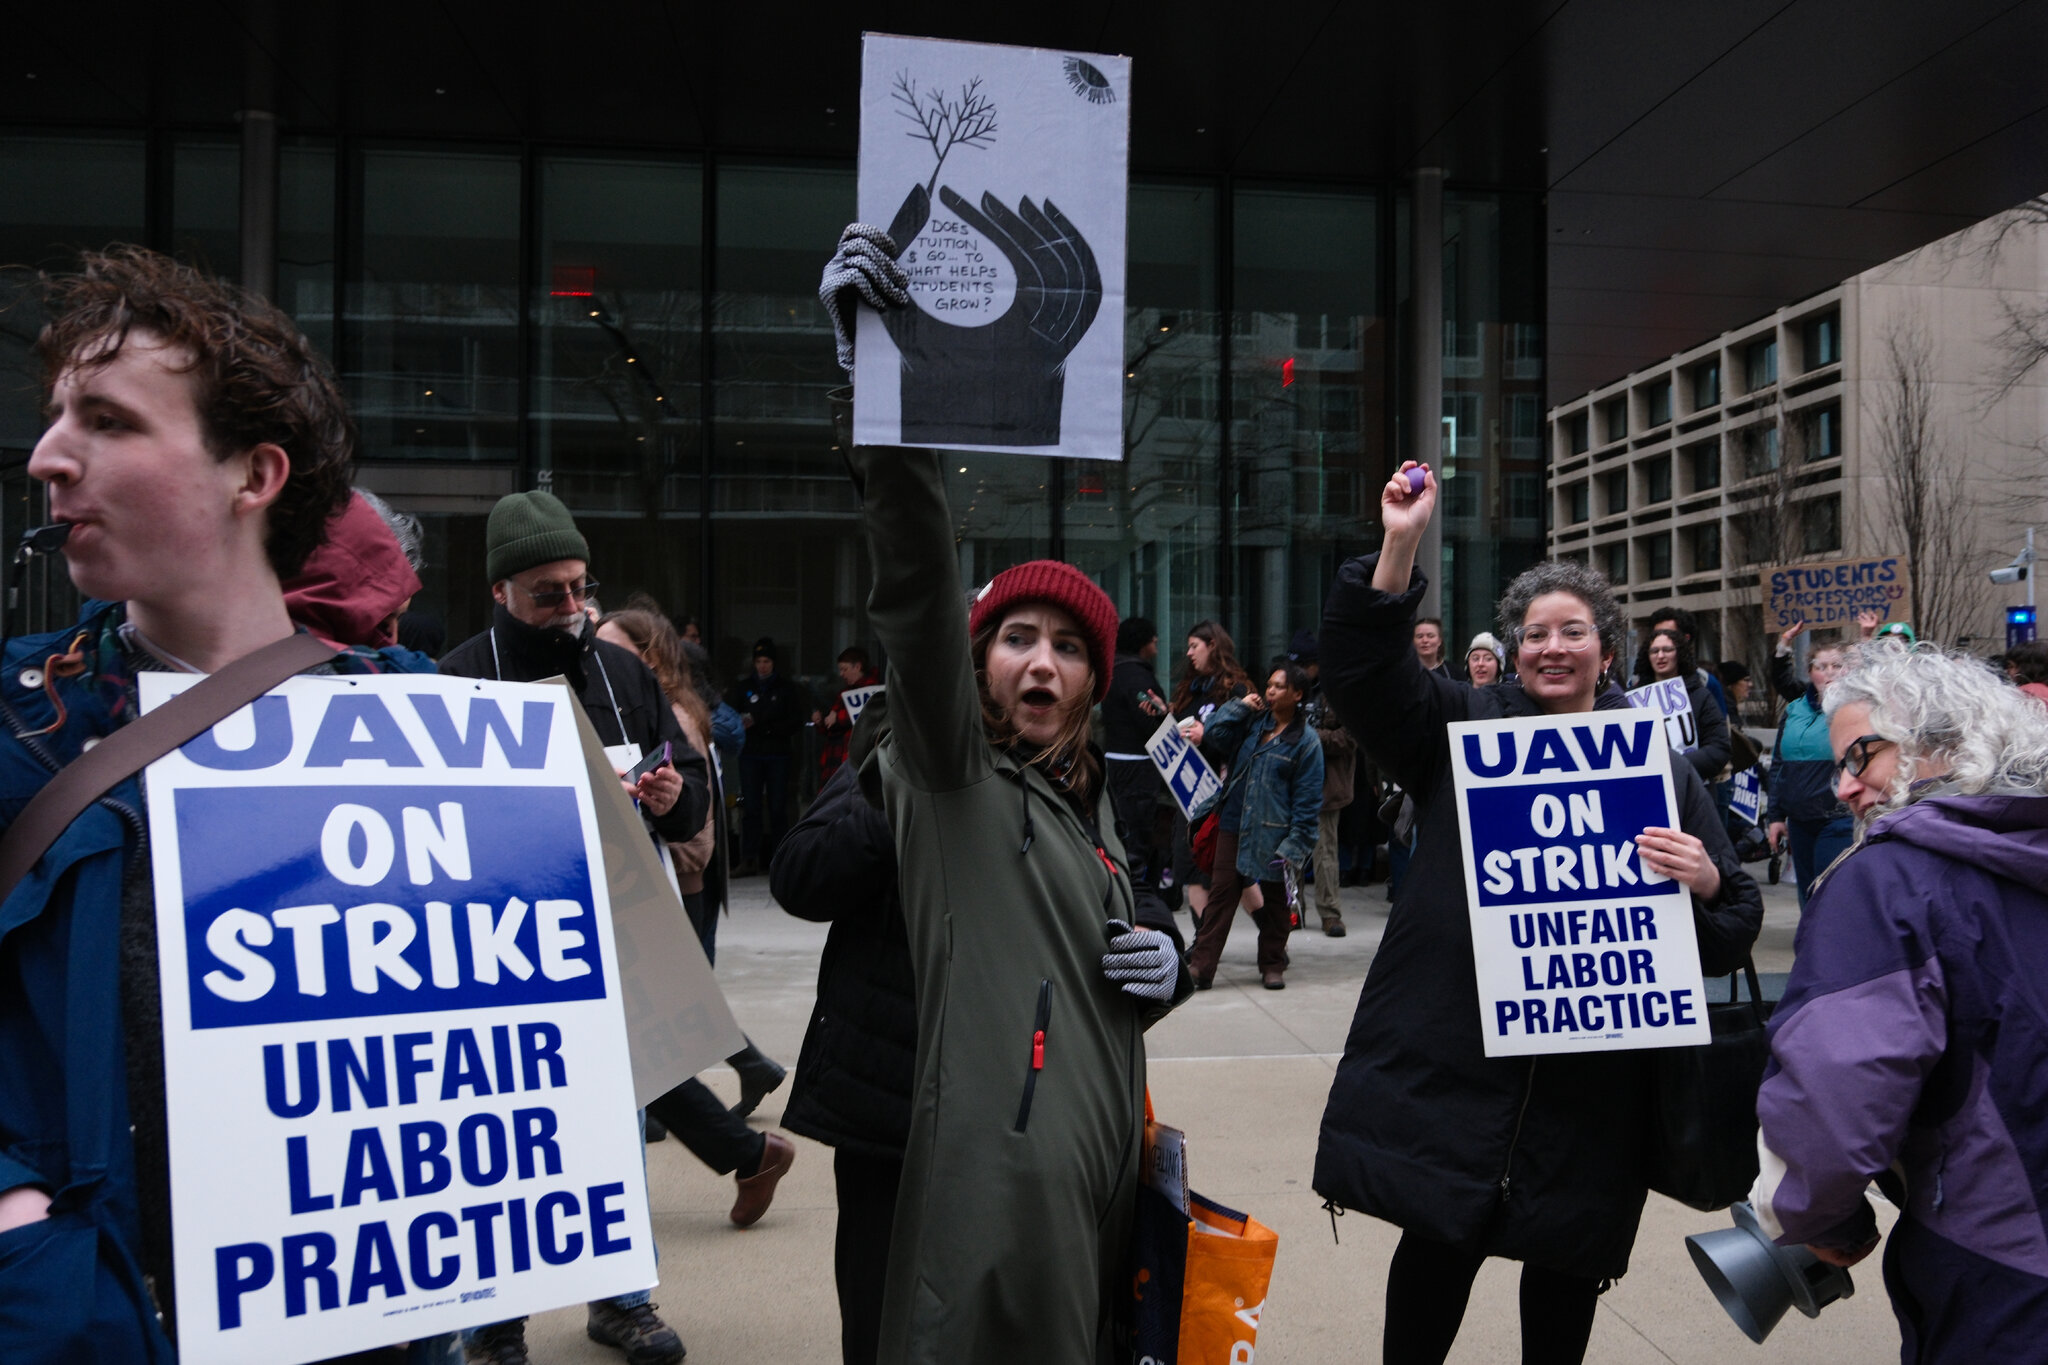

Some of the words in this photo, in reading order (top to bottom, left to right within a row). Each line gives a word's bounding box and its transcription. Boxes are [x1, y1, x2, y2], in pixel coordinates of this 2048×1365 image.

[917, 237, 978, 251] TUITION
[931, 219, 969, 235] DOES
[949, 265, 998, 278] HELPS
[965, 252, 984, 263] TO
[912, 280, 995, 294] STUDENTS
[1771, 558, 1898, 596] STUDENTS
[1784, 584, 1888, 608] PROFESSORS
[847, 691, 876, 708] UA
[1655, 679, 1687, 715] US
[171, 693, 555, 771] UAW
[1152, 723, 1187, 770] UAW
[1462, 720, 1654, 778] UAW
[1530, 789, 1605, 838] ON
[320, 801, 472, 887] ON
[203, 896, 592, 1002] STRIKE
[1509, 906, 1658, 949] UNFAIR
[1521, 949, 1657, 991] LABOR
[1495, 989, 1697, 1036] PRACTICE
[263, 1021, 568, 1119] UNFAIR
[286, 1107, 563, 1215] LABOR
[215, 1181, 632, 1331] PRACTICE
